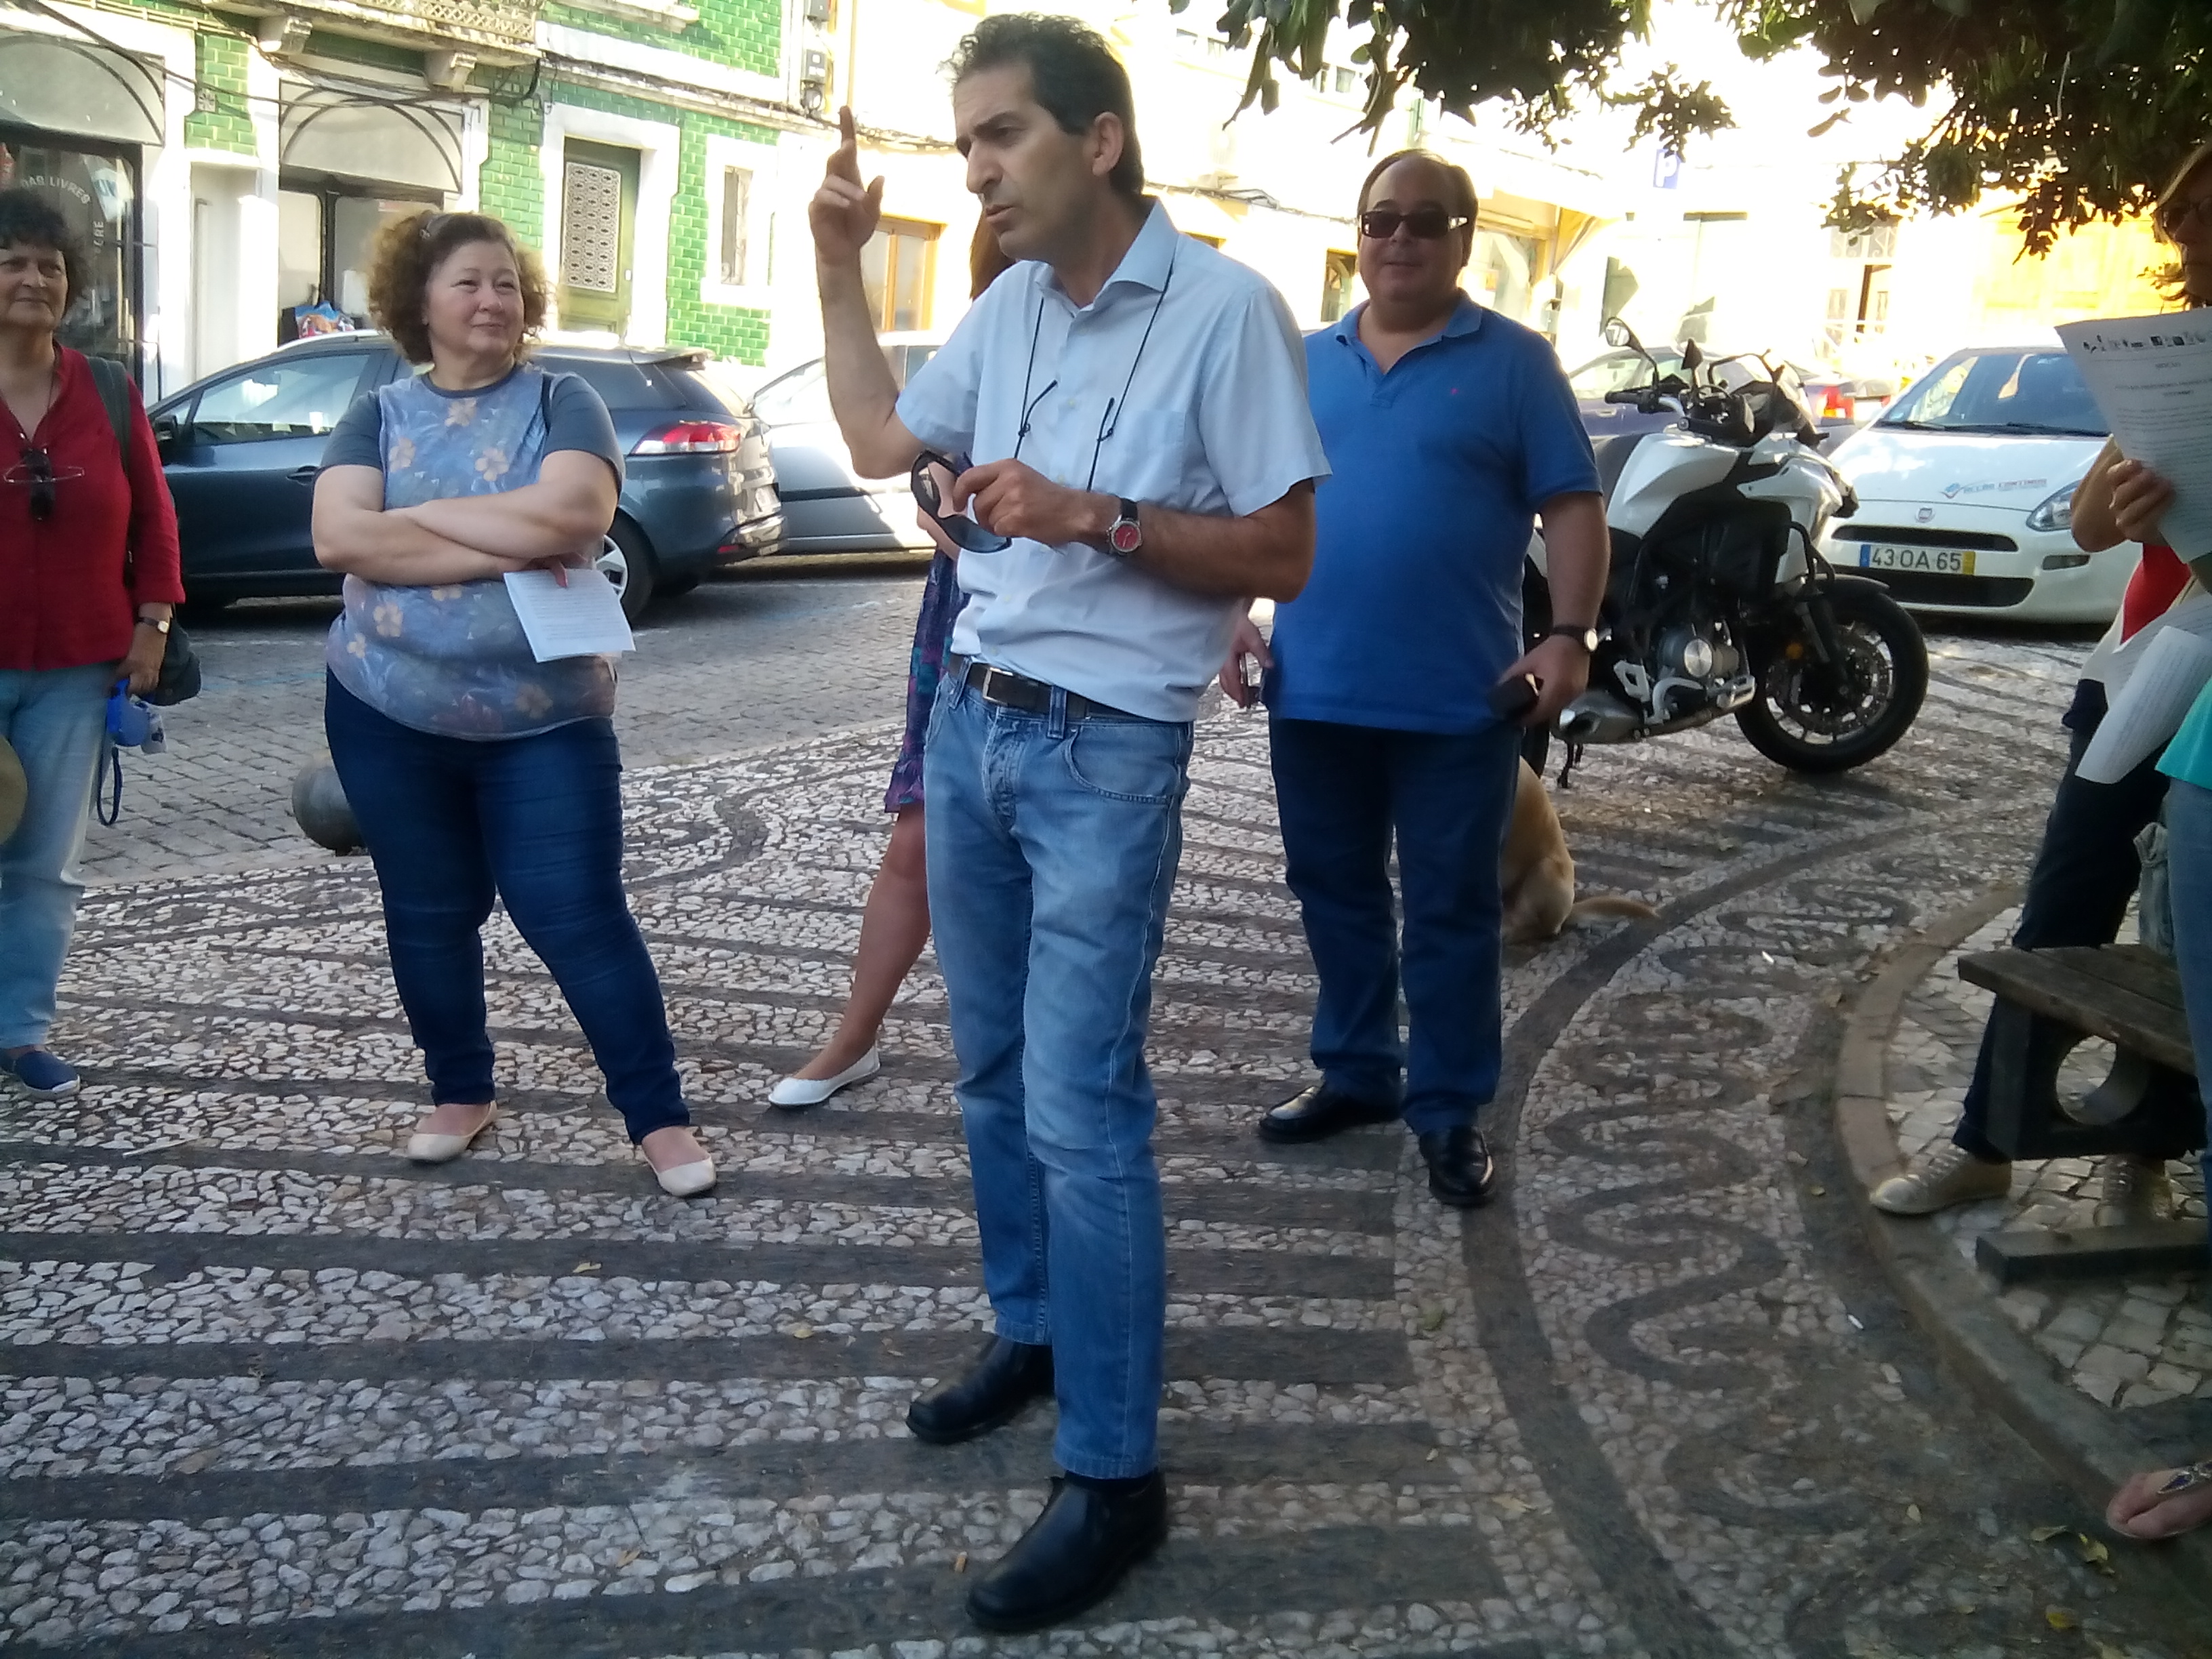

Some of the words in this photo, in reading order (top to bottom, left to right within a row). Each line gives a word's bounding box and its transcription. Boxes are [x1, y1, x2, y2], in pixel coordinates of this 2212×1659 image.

[1656, 151, 1677, 188] P
[48, 176, 91, 205] LIVRES
[1872, 547, 1895, 567] 43
[1900, 550, 1930, 570] OA
[1936, 552, 1962, 571] 65
